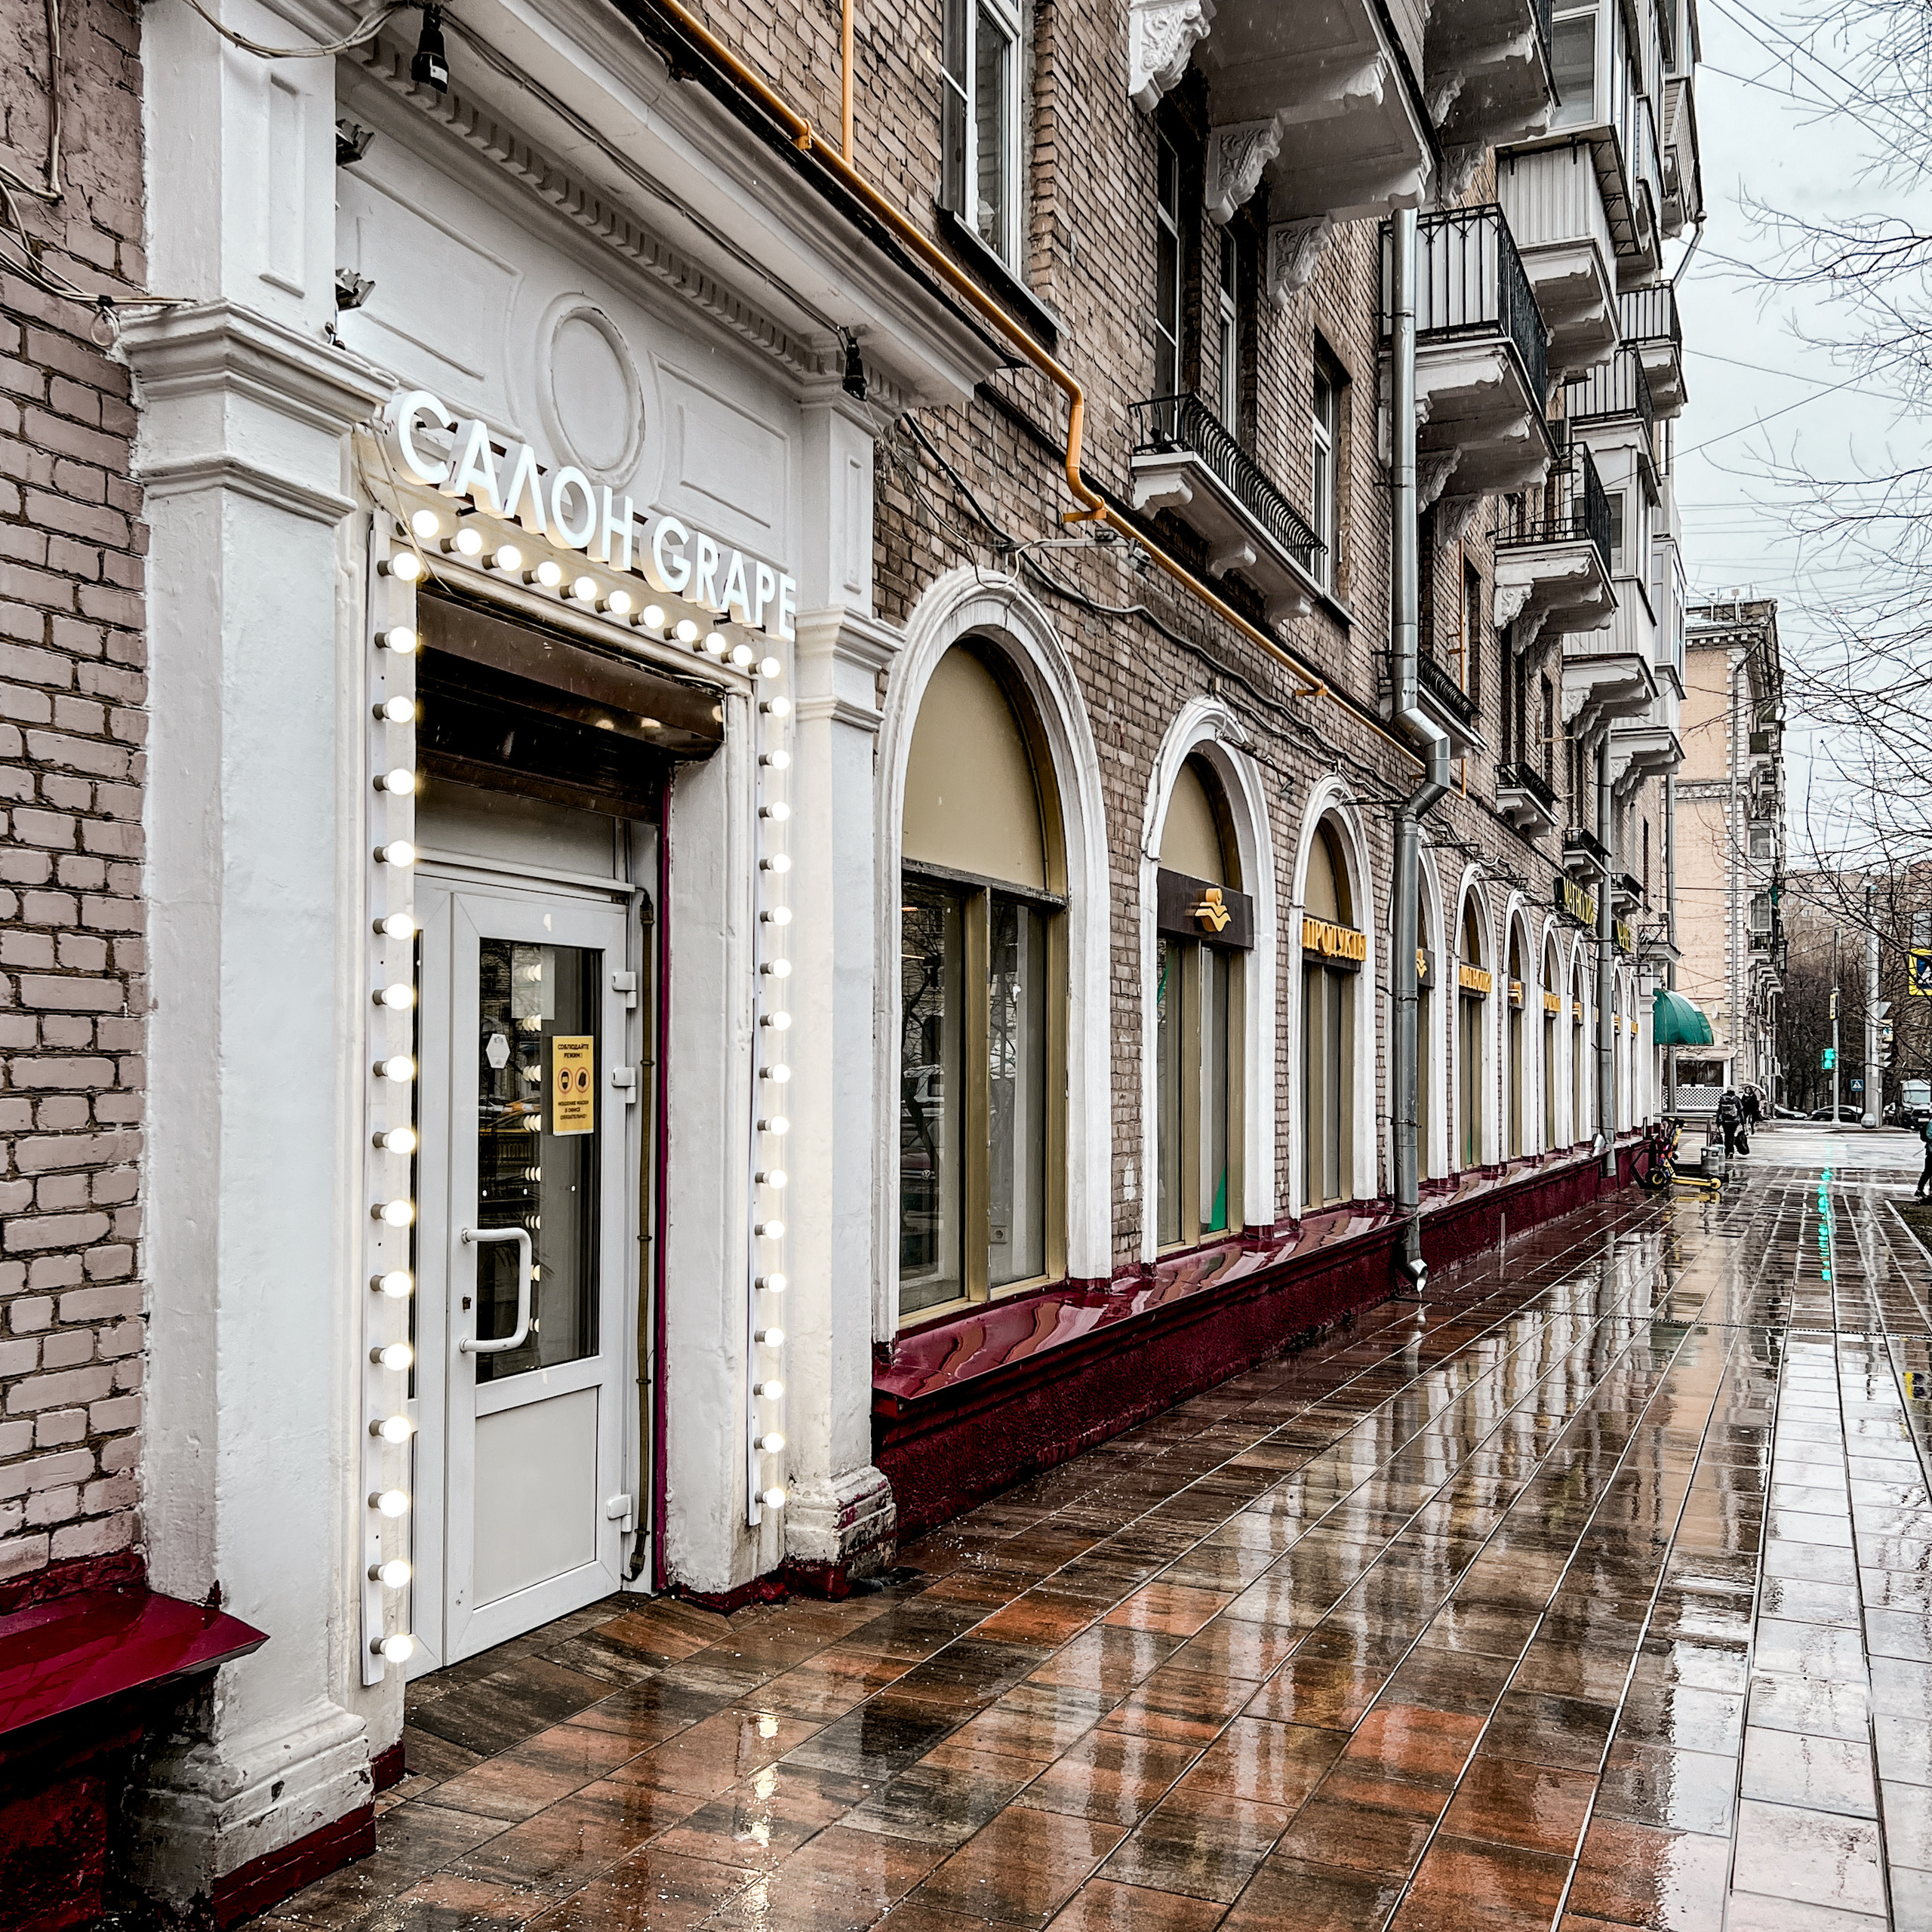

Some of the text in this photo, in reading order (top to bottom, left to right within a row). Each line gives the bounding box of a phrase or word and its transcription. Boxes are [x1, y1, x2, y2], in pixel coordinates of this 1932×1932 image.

[388, 390, 797, 642] САЛОН GRAPE
[1302, 915, 1367, 961] ПРОДУКТЫ
